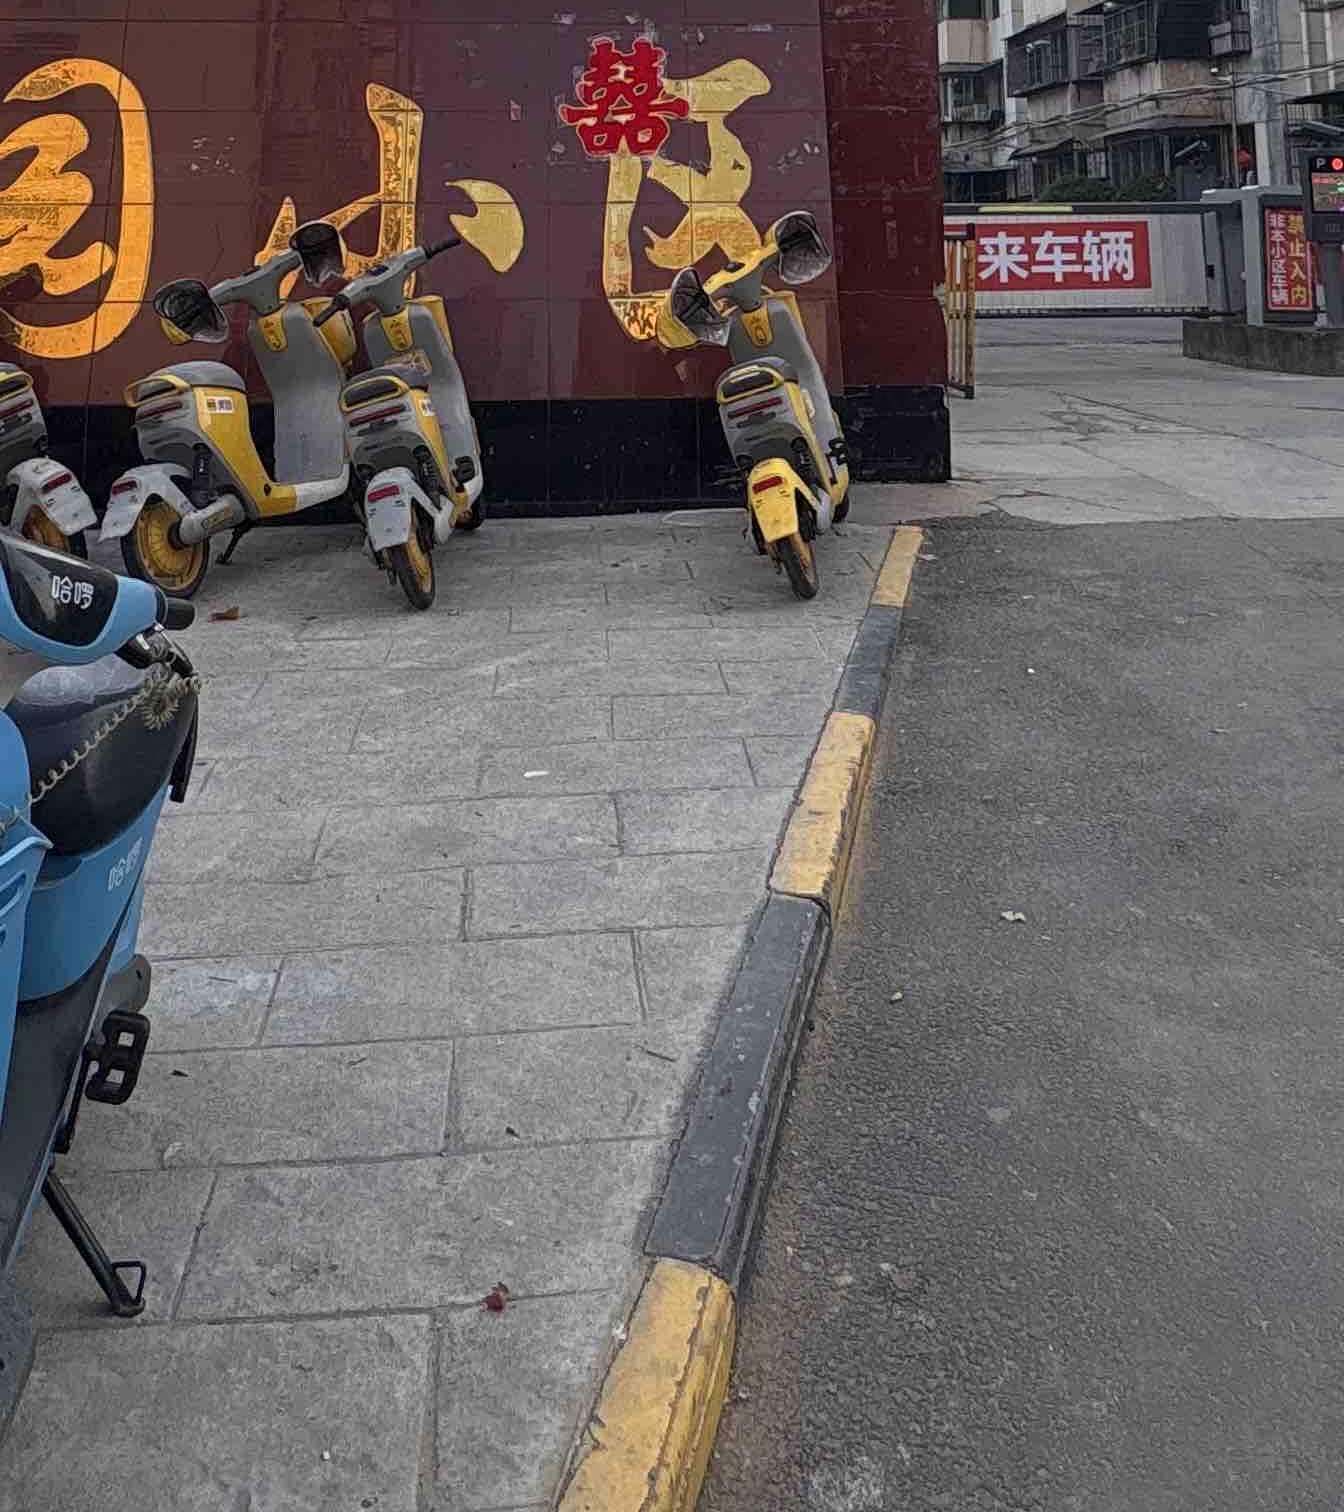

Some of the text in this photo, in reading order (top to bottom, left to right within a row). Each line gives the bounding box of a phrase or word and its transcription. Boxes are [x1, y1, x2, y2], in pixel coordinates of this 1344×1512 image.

[956, 230, 1135, 283] 来车辆
[1287, 214, 1307, 306] 禁止入内
[51, 575, 95, 609] 哈啰
